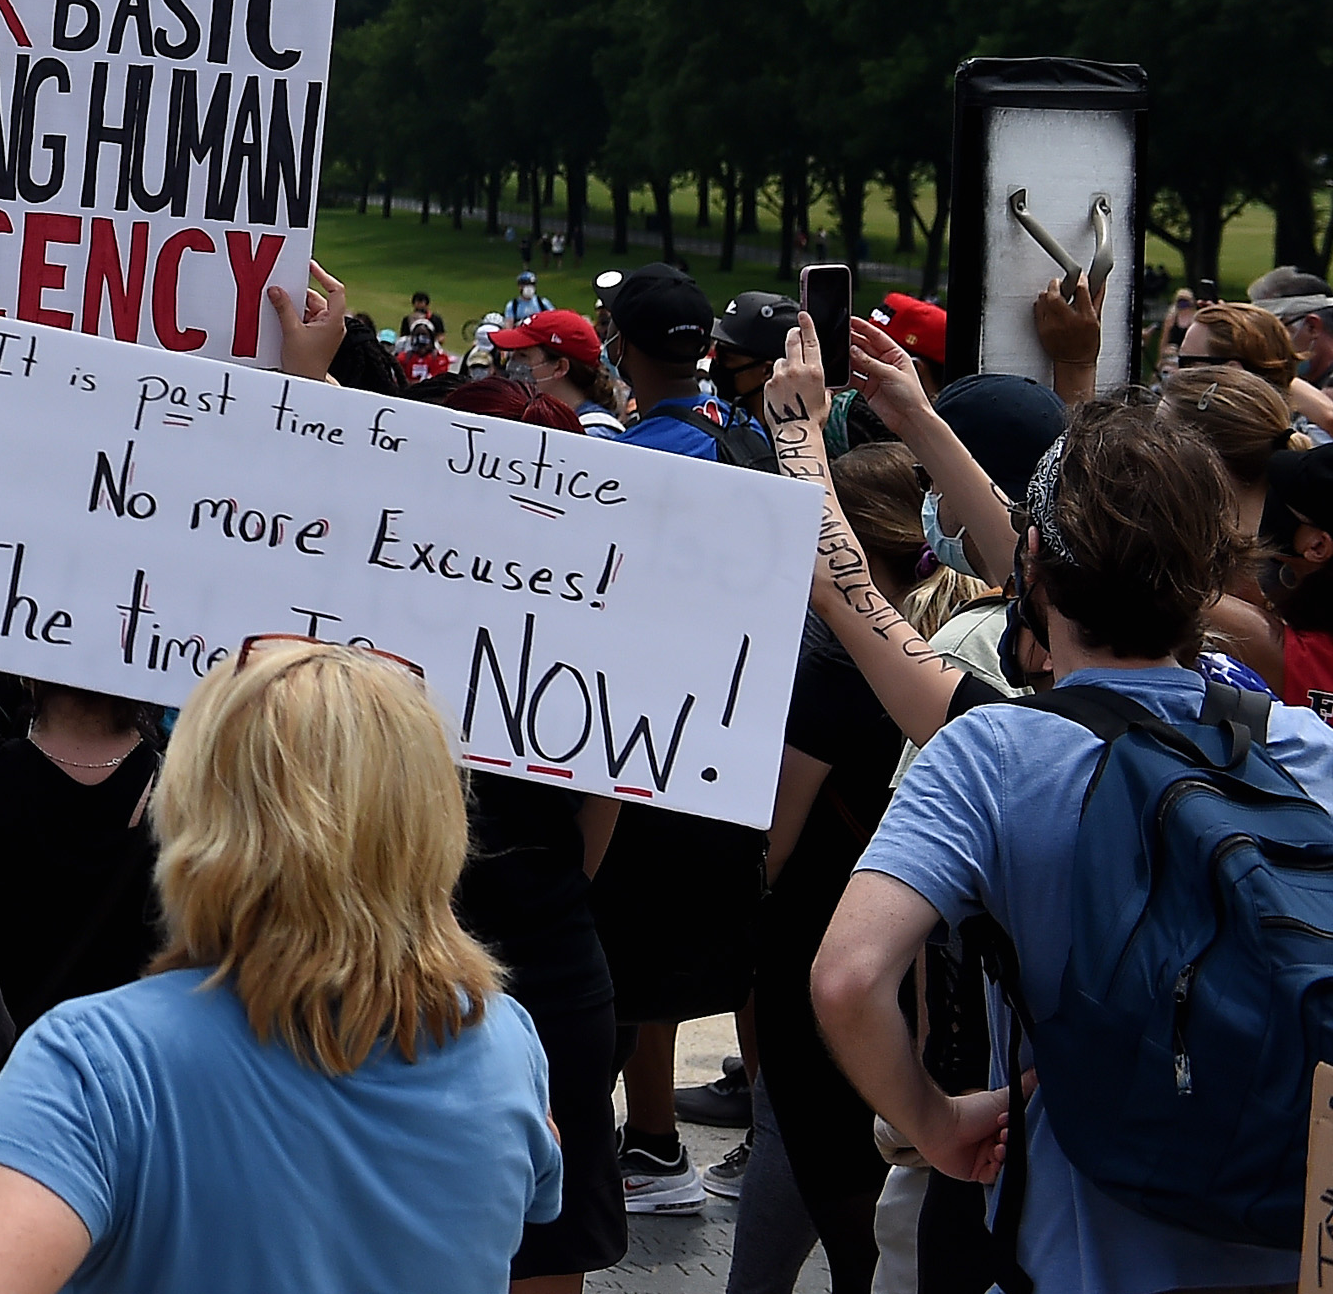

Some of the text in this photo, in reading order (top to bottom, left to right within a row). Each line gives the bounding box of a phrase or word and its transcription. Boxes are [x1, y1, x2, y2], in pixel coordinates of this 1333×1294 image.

[80, 59, 324, 230] HUMAN
[68, 363, 98, 395] is
[135, 371, 237, 432] past
[271, 378, 346, 449] time
[368, 407, 410, 455] for
[446, 420, 629, 507] Justice
[87, 439, 622, 612] No more Excuses!
[118, 568, 229, 678] time
[460, 611, 752, 797] NOW!
